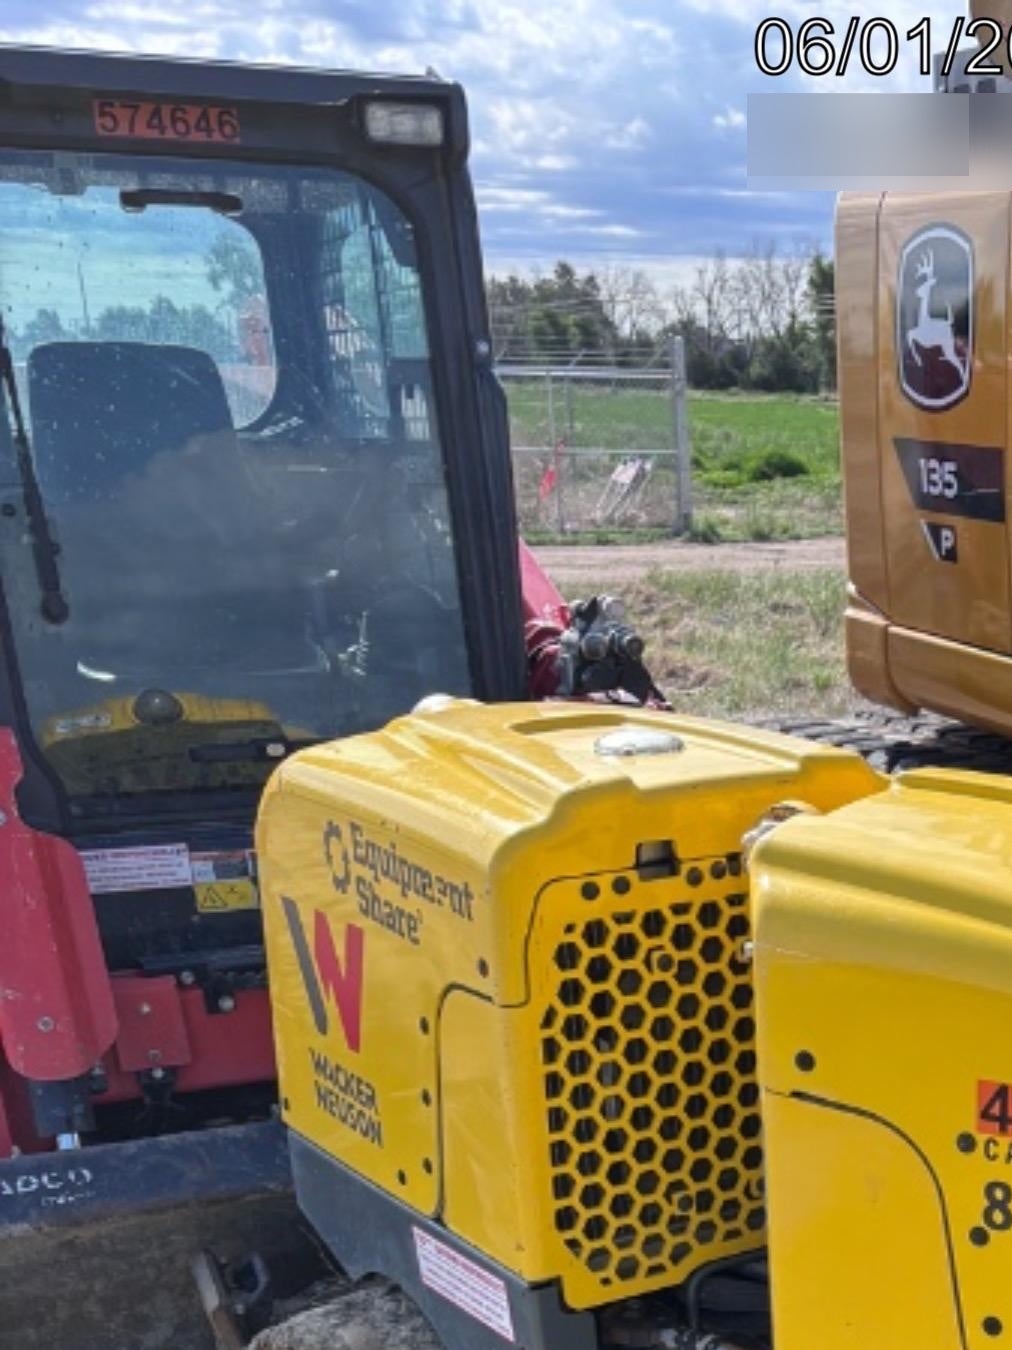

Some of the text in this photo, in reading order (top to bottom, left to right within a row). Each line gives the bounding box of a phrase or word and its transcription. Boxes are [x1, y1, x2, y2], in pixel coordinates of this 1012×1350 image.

[98, 101, 238, 138] 574646
[919, 457, 958, 498] 135
[940, 527, 954, 556] P
[355, 874, 422, 946] Share
